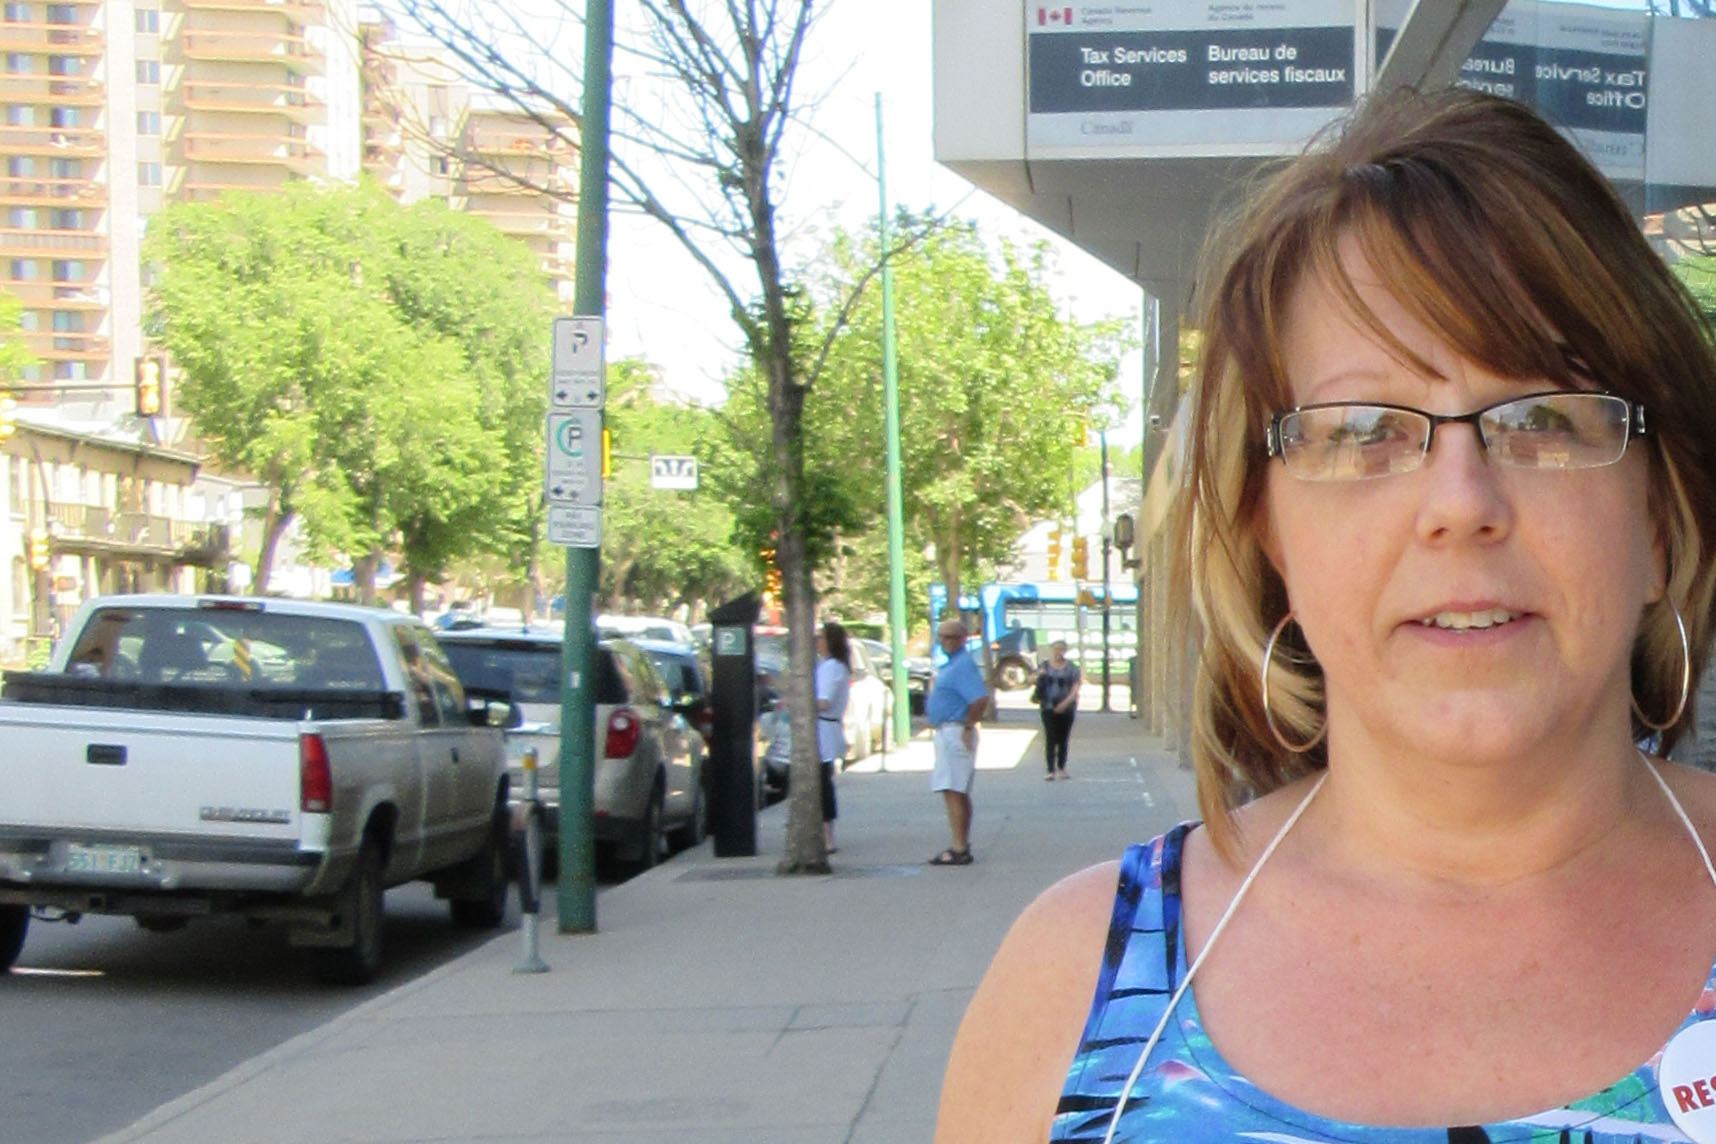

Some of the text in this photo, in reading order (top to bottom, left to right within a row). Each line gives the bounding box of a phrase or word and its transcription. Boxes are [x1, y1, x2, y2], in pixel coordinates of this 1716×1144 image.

[1081, 46, 1187, 64] Tax Services
[1208, 43, 1297, 61] Bureau de
[1081, 70, 1131, 87] Office
[1208, 65, 1346, 84] services fiscaux
